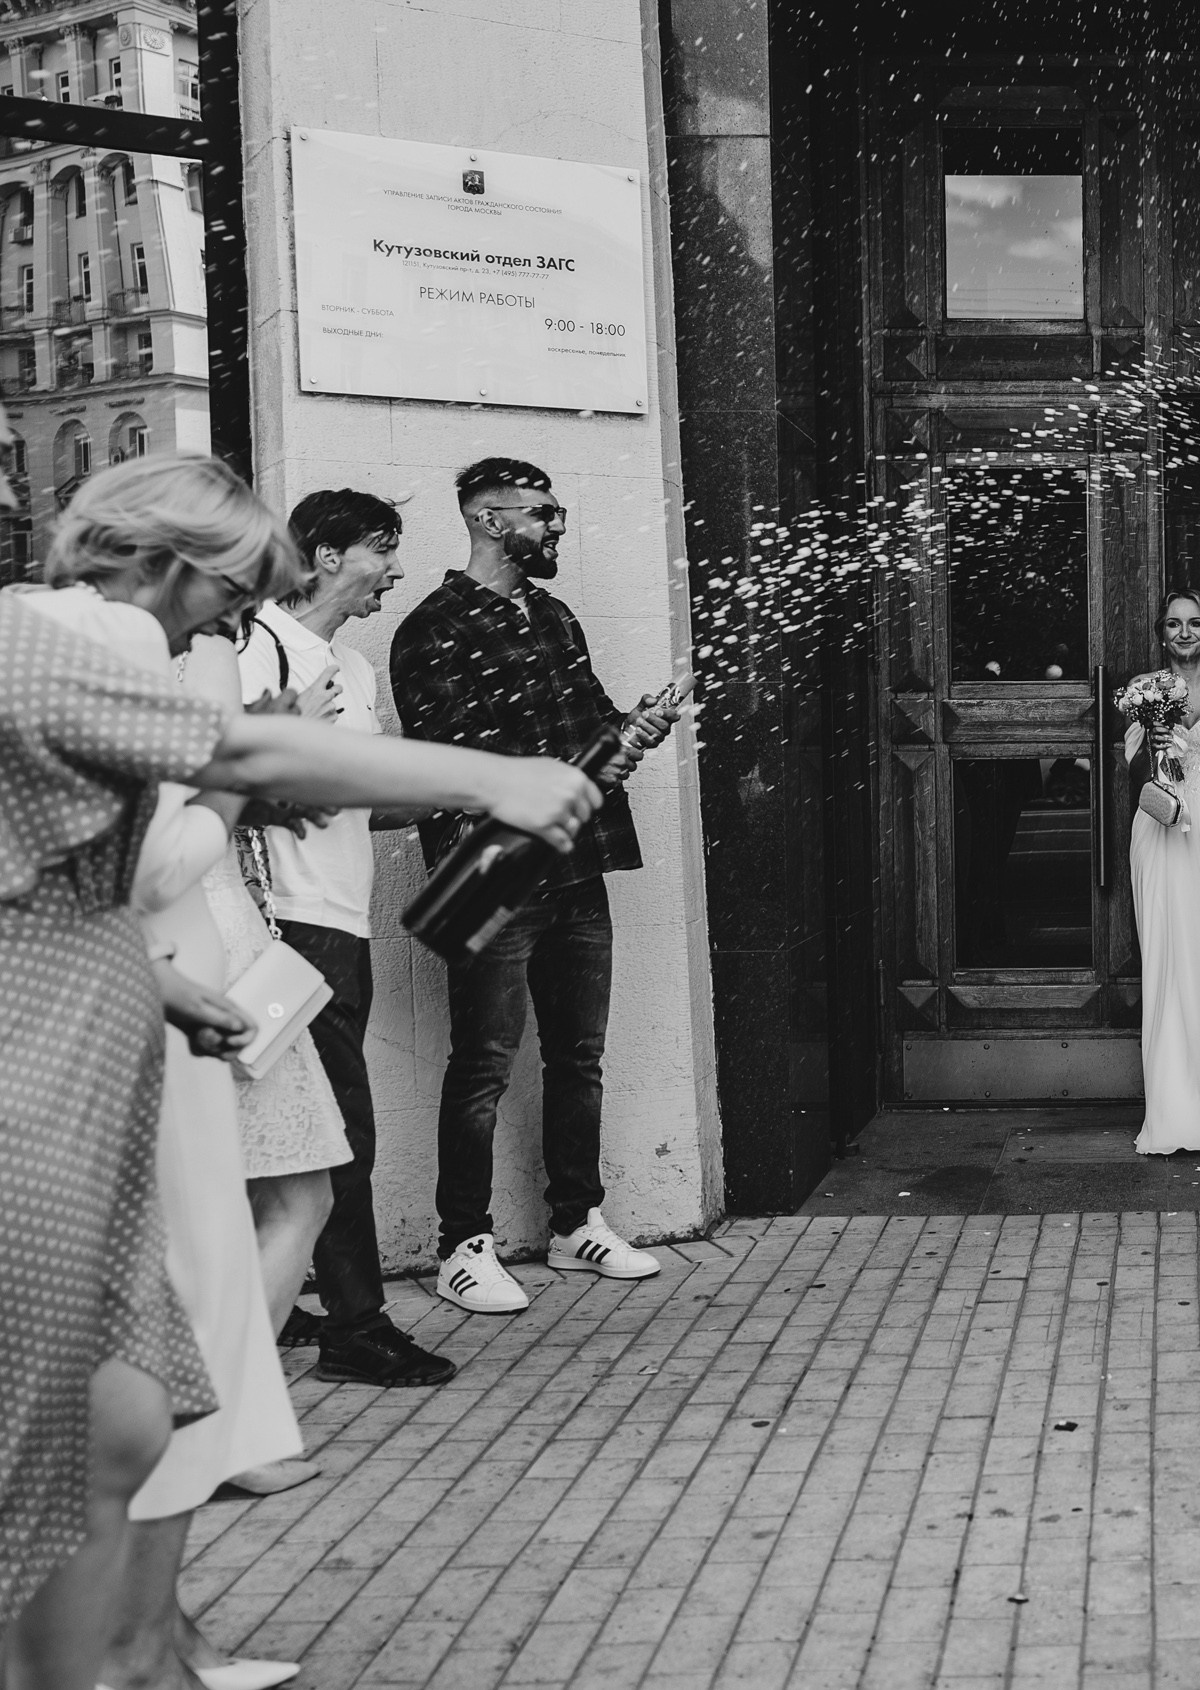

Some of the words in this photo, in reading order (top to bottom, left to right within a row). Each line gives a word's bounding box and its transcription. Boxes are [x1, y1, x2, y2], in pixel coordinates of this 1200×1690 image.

[383, 189, 424, 200] УПРАВЛЕНИЕ
[425, 194, 453, 203] ЗАПИСИ
[453, 197, 474, 205] АКТОВ
[474, 199, 524, 211] ГРАЖДАНСКОГО
[525, 205, 562, 215] СОСТОЯНИЯ
[447, 204, 474, 214] ГОРОДА
[474, 208, 502, 216] МОСКВЫ
[373, 239, 480, 263] Кутузовский
[485, 254, 532, 268] отдел
[536, 255, 576, 272] ЗАГС
[423, 262, 459, 272] Кутузовский
[501, 269, 517, 278] (495)
[518, 271, 549, 280] 777-77-77
[419, 286, 475, 303] РЕЖИМ
[479, 292, 535, 309] РАБОТЫ
[321, 304, 355, 313] ВТОРНИК
[361, 307, 395, 317] СУББОТА
[322, 326, 364, 336] ВЫХОДНЫЕ
[365, 330, 384, 338] ДНИ:
[544, 318, 576, 332] 9:00
[589, 322, 626, 337] 18:00
[547, 346, 588, 356] воскресенье,
[588, 350, 626, 358] понедельник
